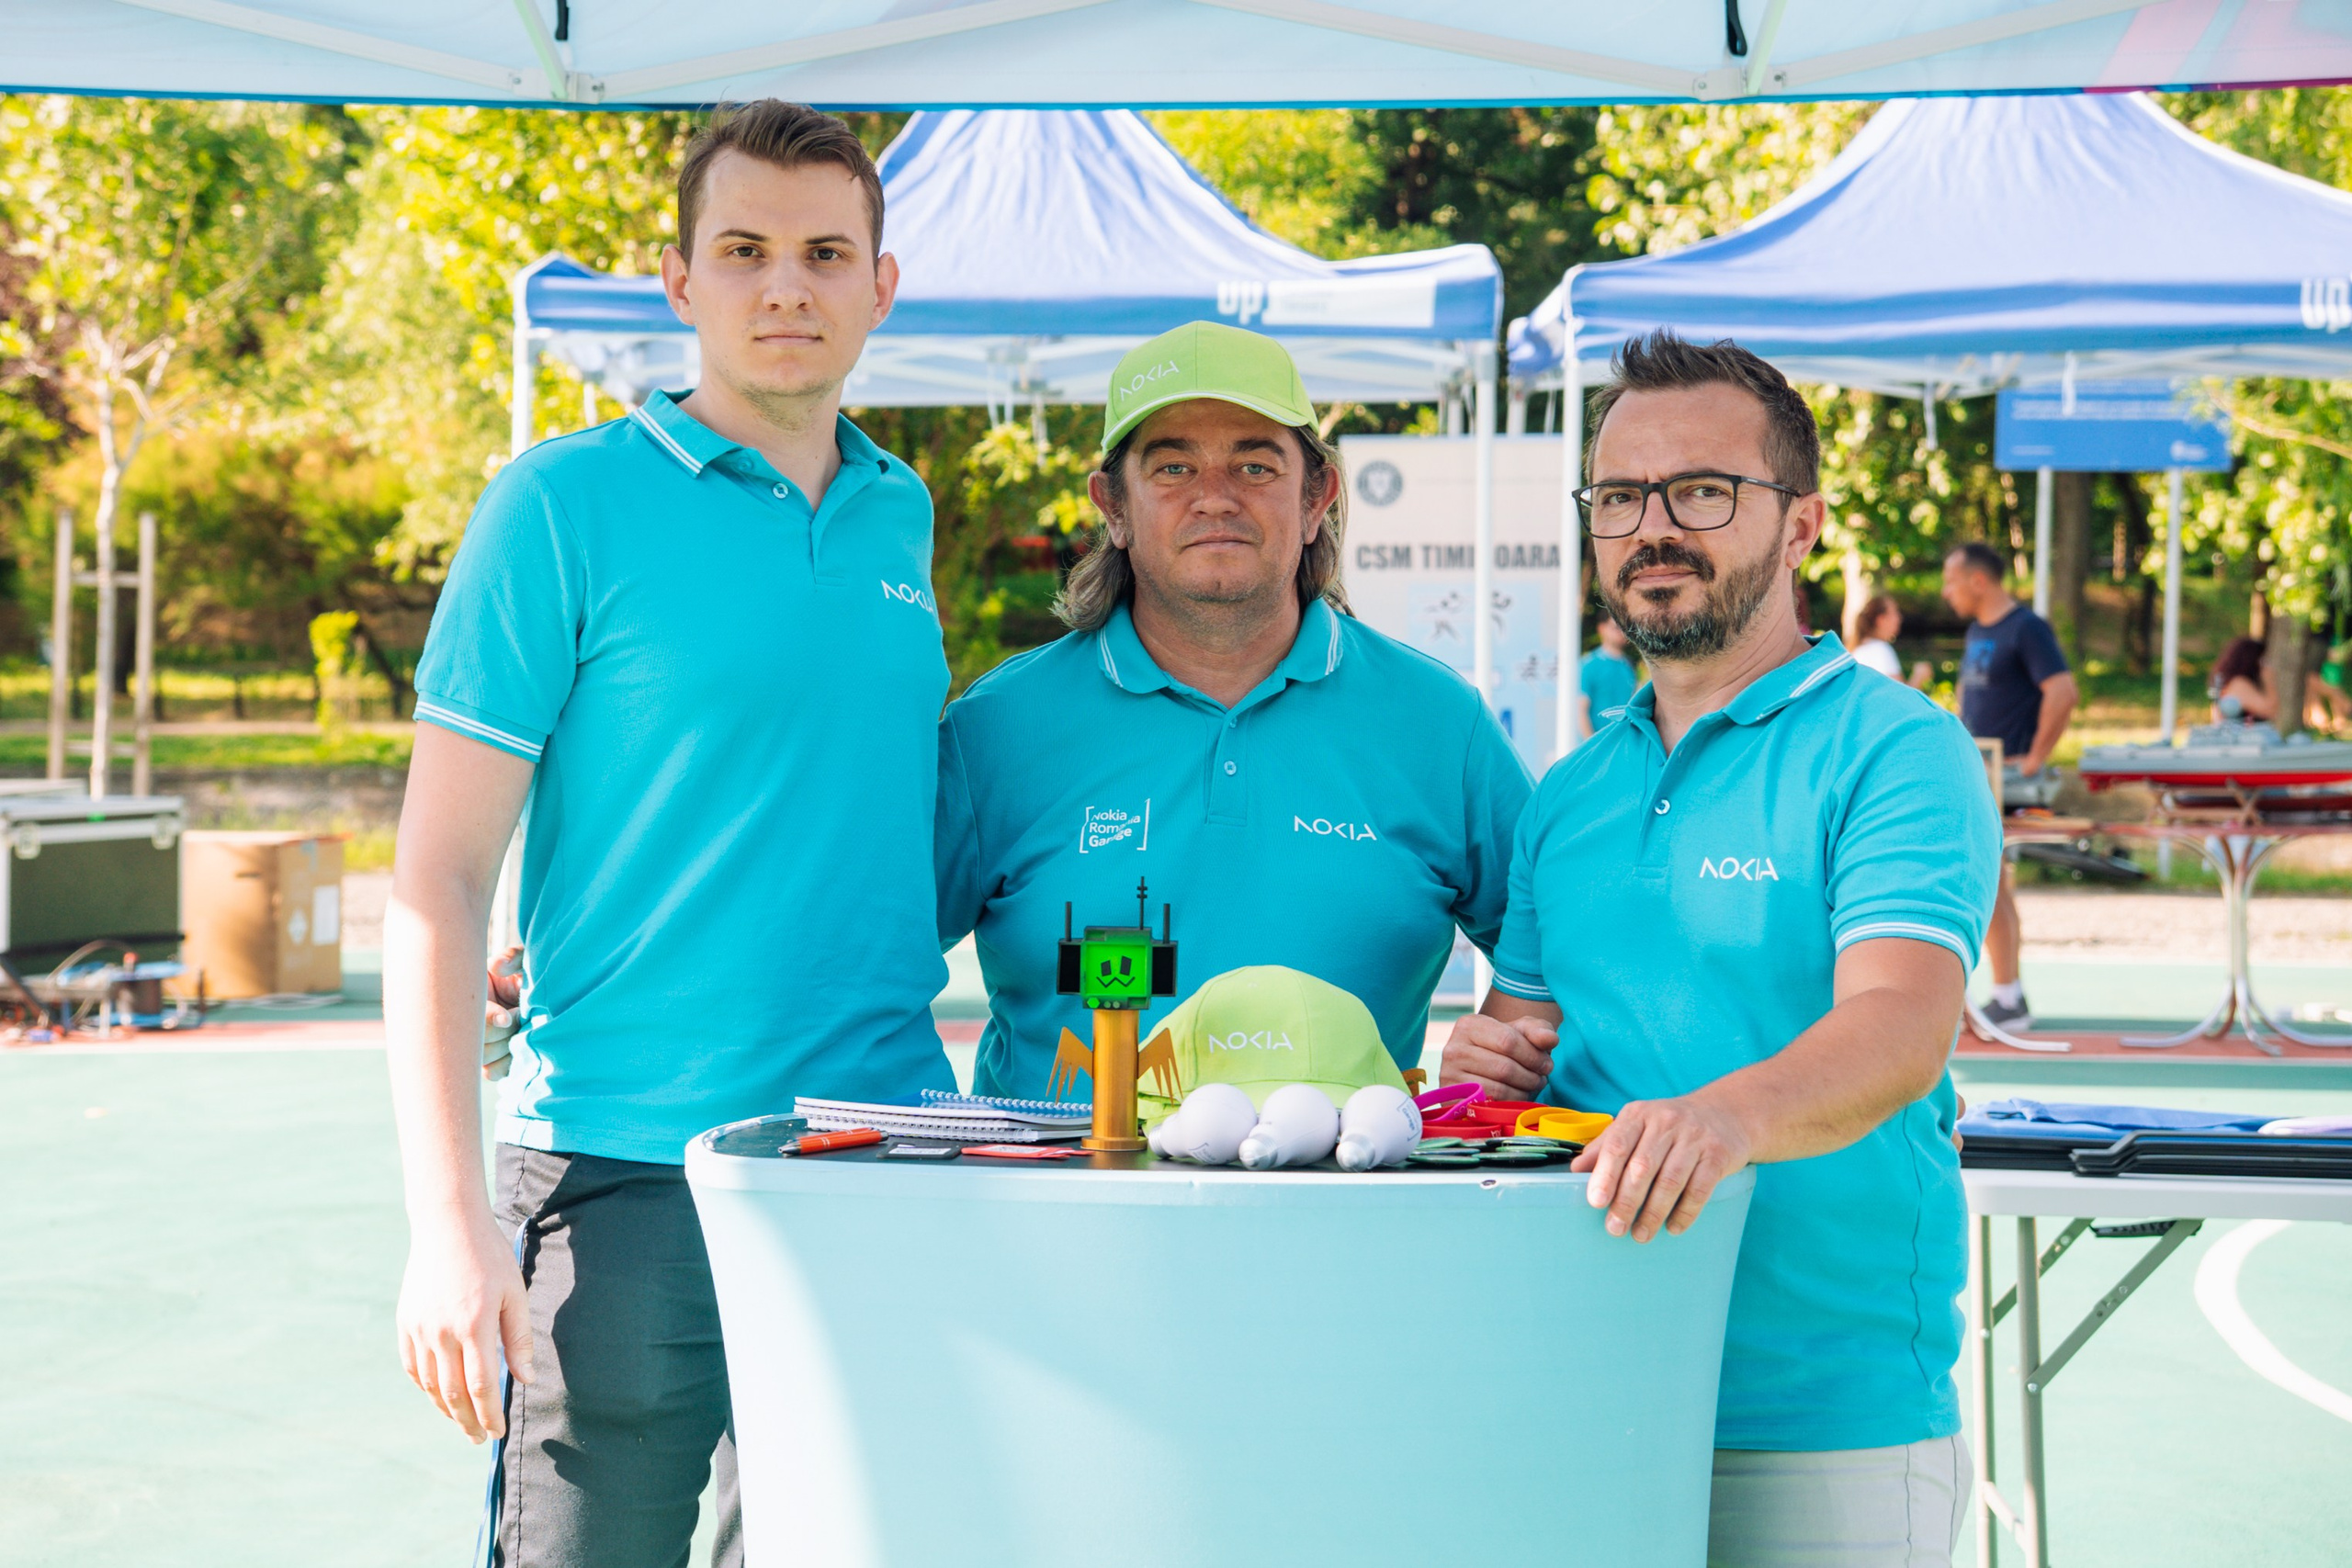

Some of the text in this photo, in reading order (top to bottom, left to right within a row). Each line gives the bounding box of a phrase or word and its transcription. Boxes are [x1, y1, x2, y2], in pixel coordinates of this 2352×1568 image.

[1119, 360, 1180, 402] NOKIA
[1356, 544, 1561, 570] CSM TIMIOARA
[1091, 808, 1127, 822] Nokia
[1294, 814, 1377, 841] NOKIA
[1699, 856, 1780, 882] NOKIA
[1208, 1030, 1294, 1055] NOKIA
